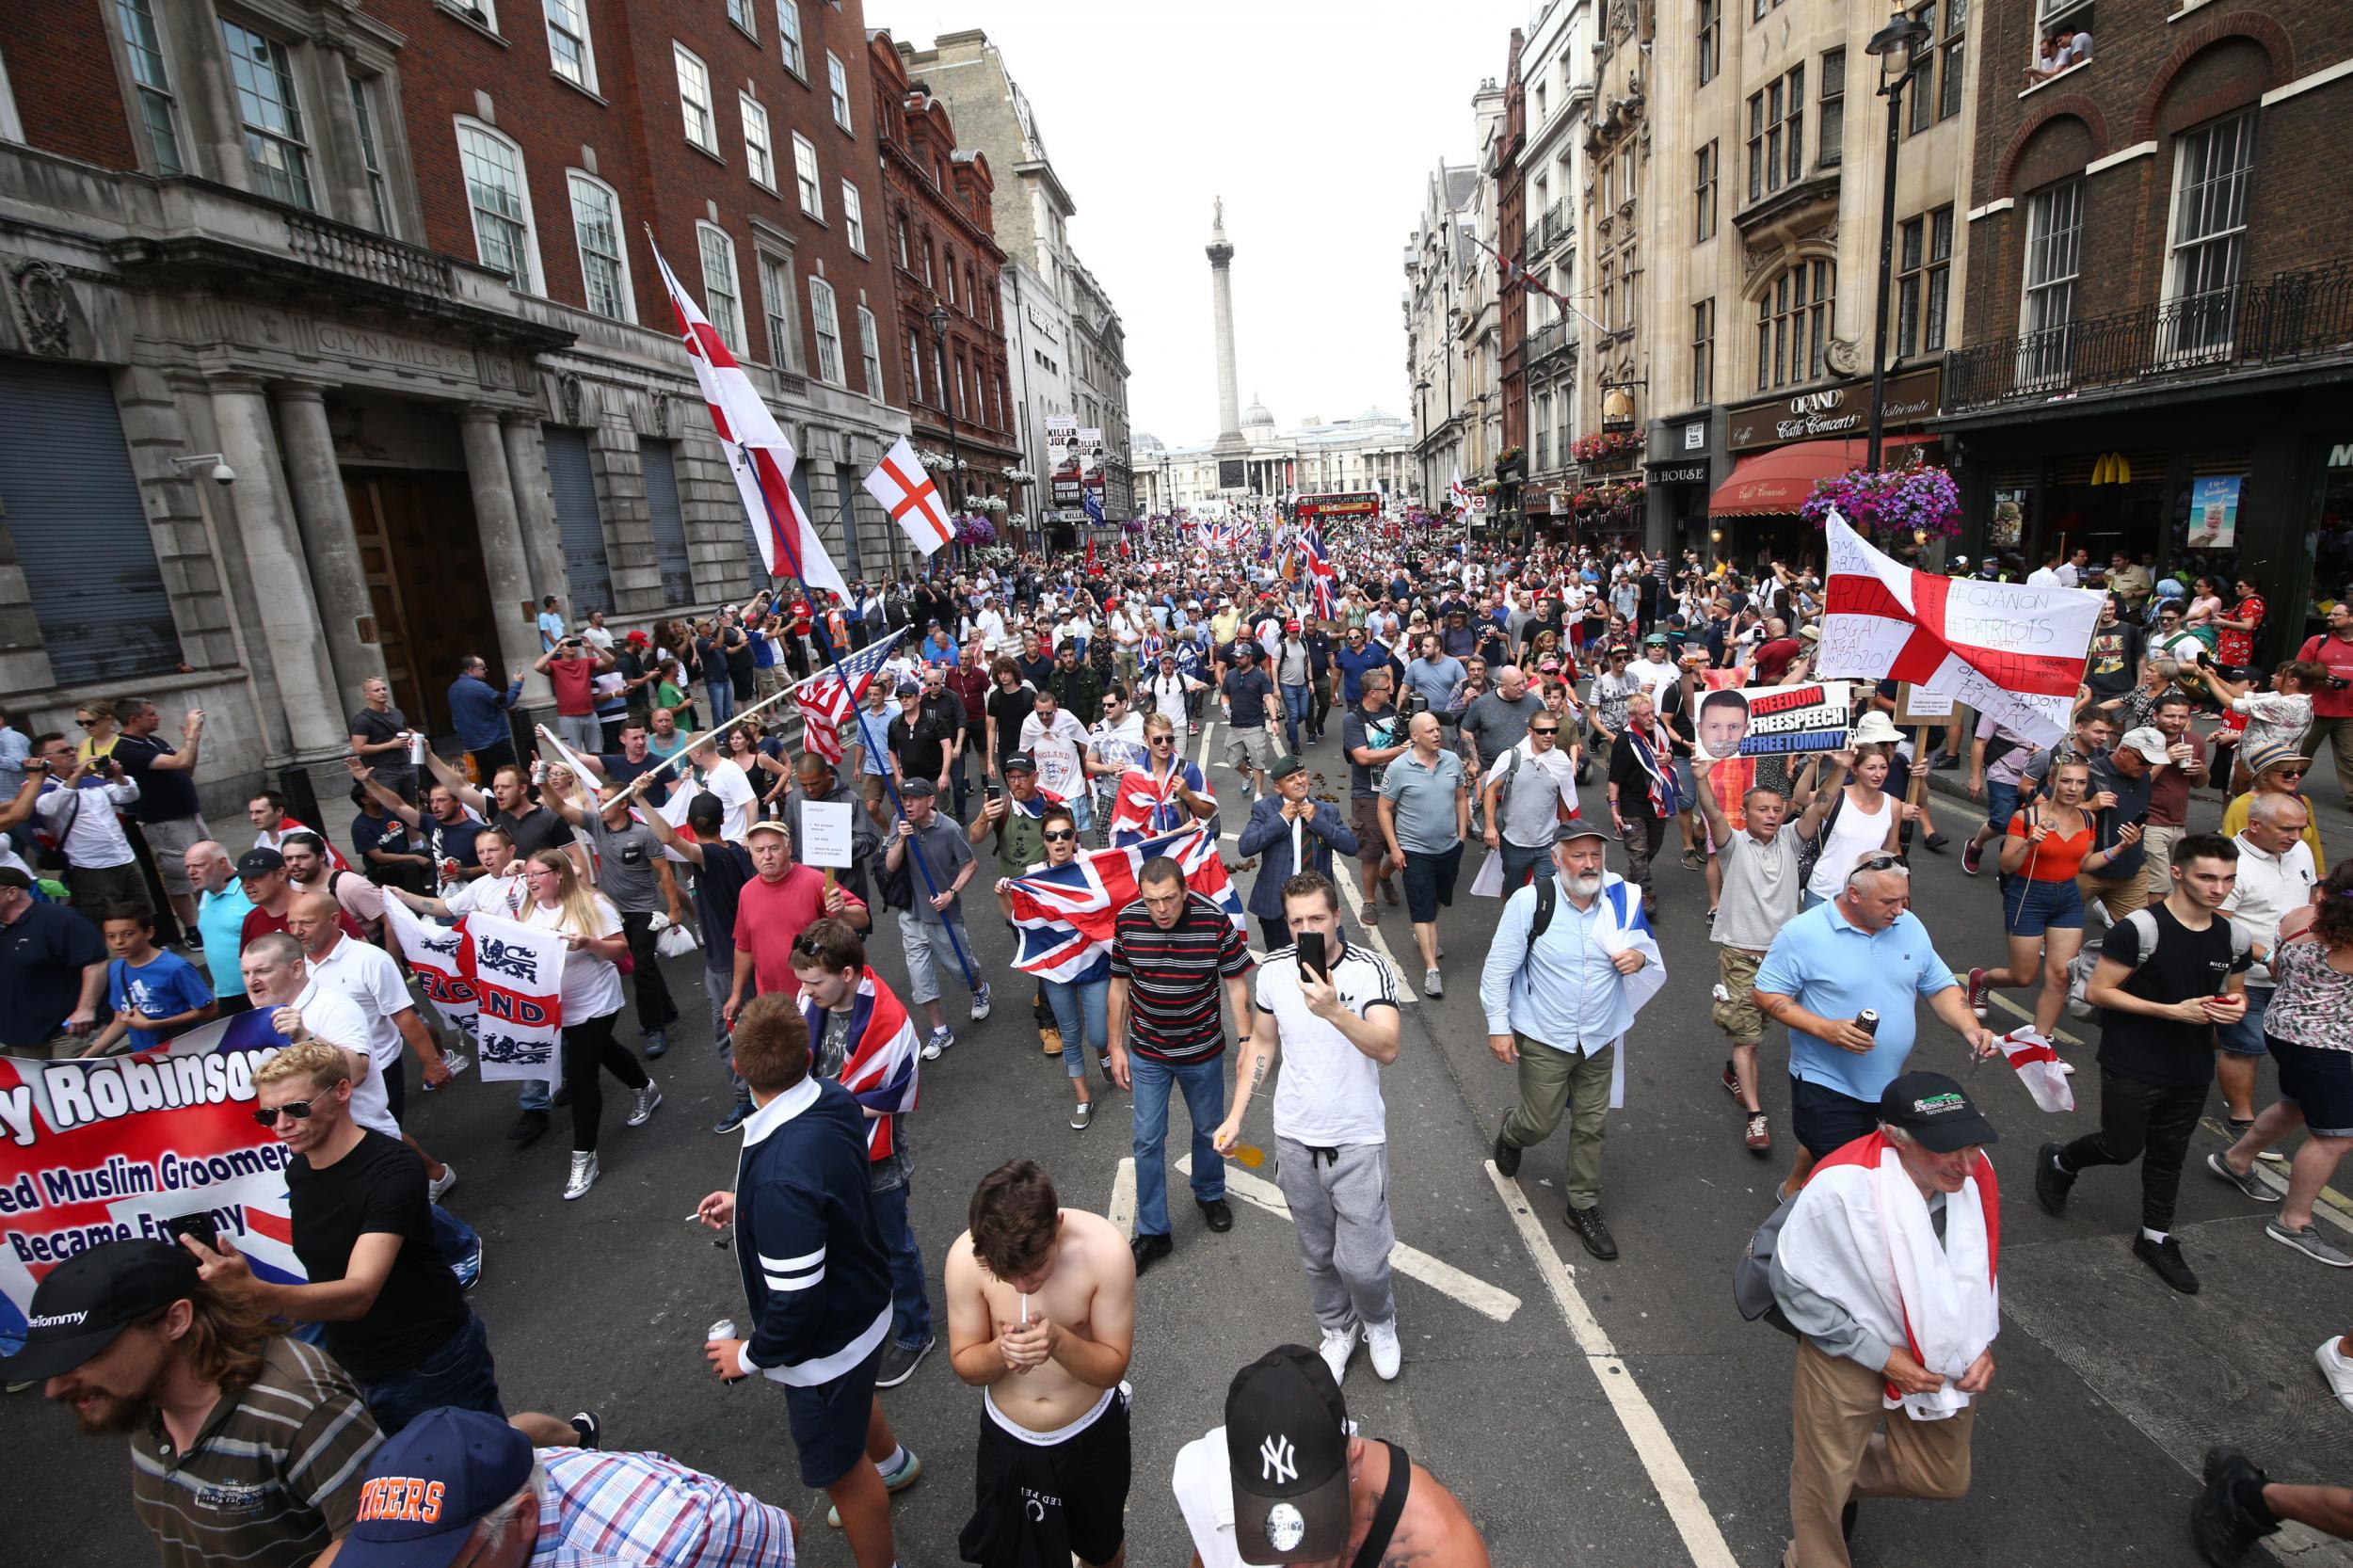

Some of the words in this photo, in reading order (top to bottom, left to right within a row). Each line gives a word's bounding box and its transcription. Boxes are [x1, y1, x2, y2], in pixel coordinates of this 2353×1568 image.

[318, 327, 380, 357] GLYN
[386, 339, 441, 368] MILLS
[1791, 389, 1845, 415] GRAND
[1049, 438, 1065, 446] JOE
[1661, 469, 1704, 482] HOUSE
[1950, 585, 2049, 610] #QANON
[1945, 617, 2054, 644] #PATRIOTS
[1749, 686, 1822, 716] FREEDOM
[1750, 707, 1845, 735] FREESPEECH
[1739, 730, 1845, 754] #FREETOMMY
[42, 1157, 154, 1205] Muslim
[8, 1223, 132, 1263] Became
[356, 1476, 445, 1524] TIGERS
